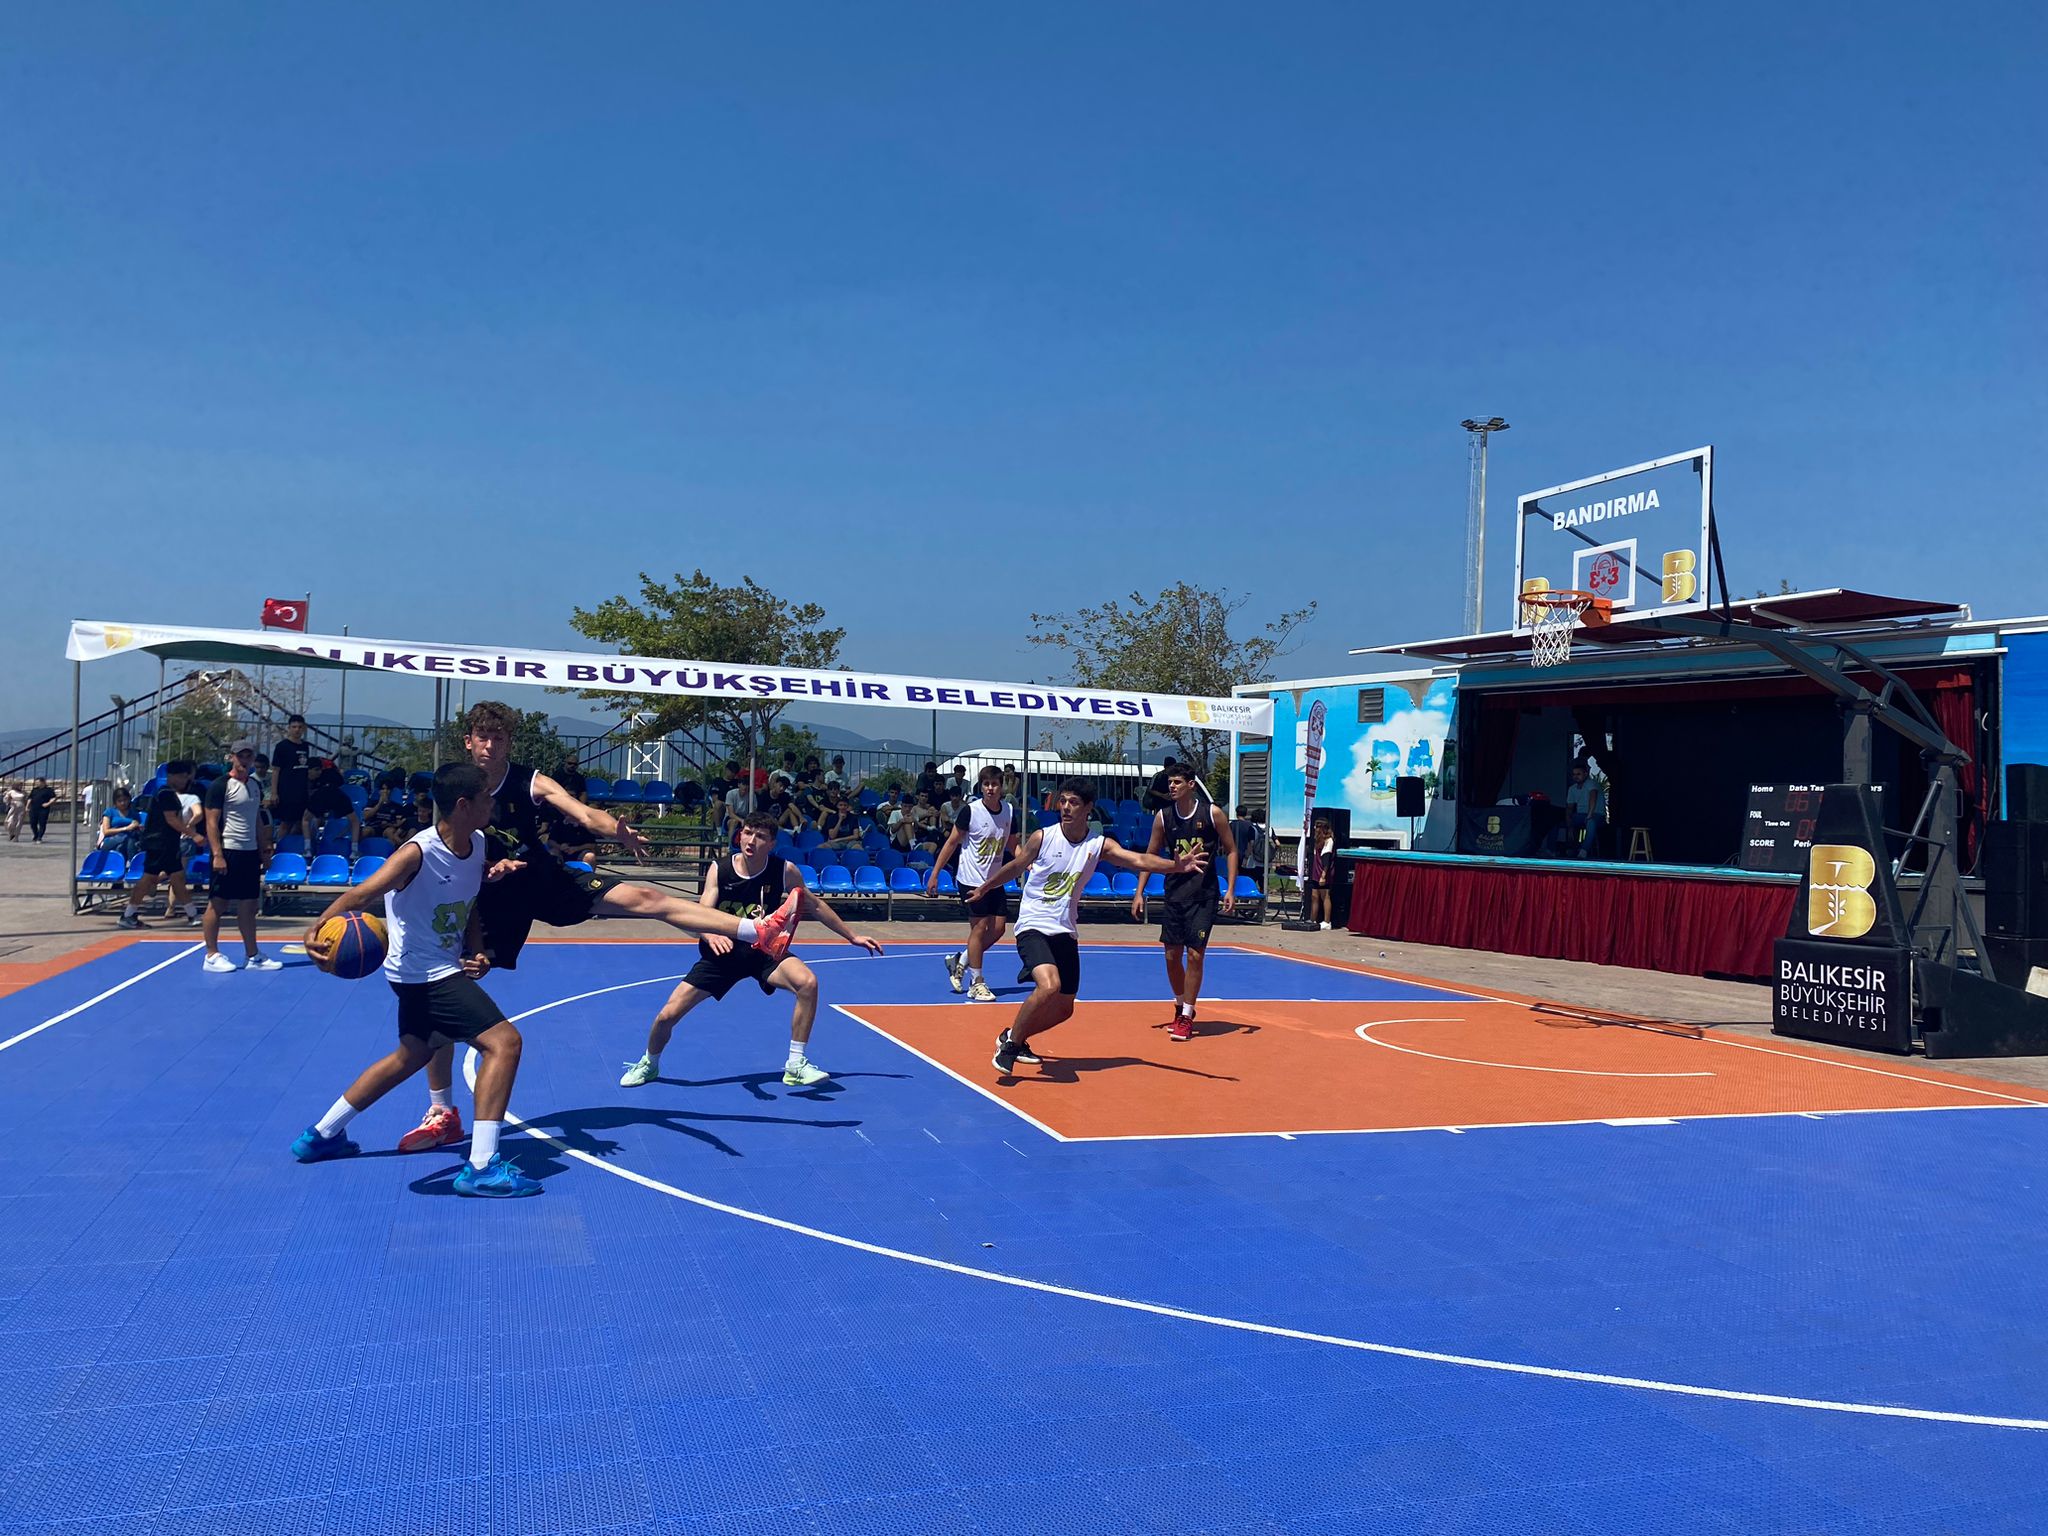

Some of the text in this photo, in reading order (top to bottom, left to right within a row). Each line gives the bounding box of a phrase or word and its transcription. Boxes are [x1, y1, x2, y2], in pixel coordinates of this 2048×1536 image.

[1553, 489, 1660, 531] BANDIRMA
[567, 662, 890, 698] BÜYÜKŞEHİR
[906, 685, 1154, 718] BELEDİYESİ
[1211, 704, 1251, 713] BALIKESİR
[1751, 785, 1774, 793] Home
[1749, 839, 1775, 847] SCORE
[1793, 840, 1811, 848] Peri
[1781, 959, 1886, 992] BALIKESİR
[1781, 983, 1886, 1015] BÜYÜKŞEHİR
[1780, 1005, 1886, 1032] BELEDİYESİ
